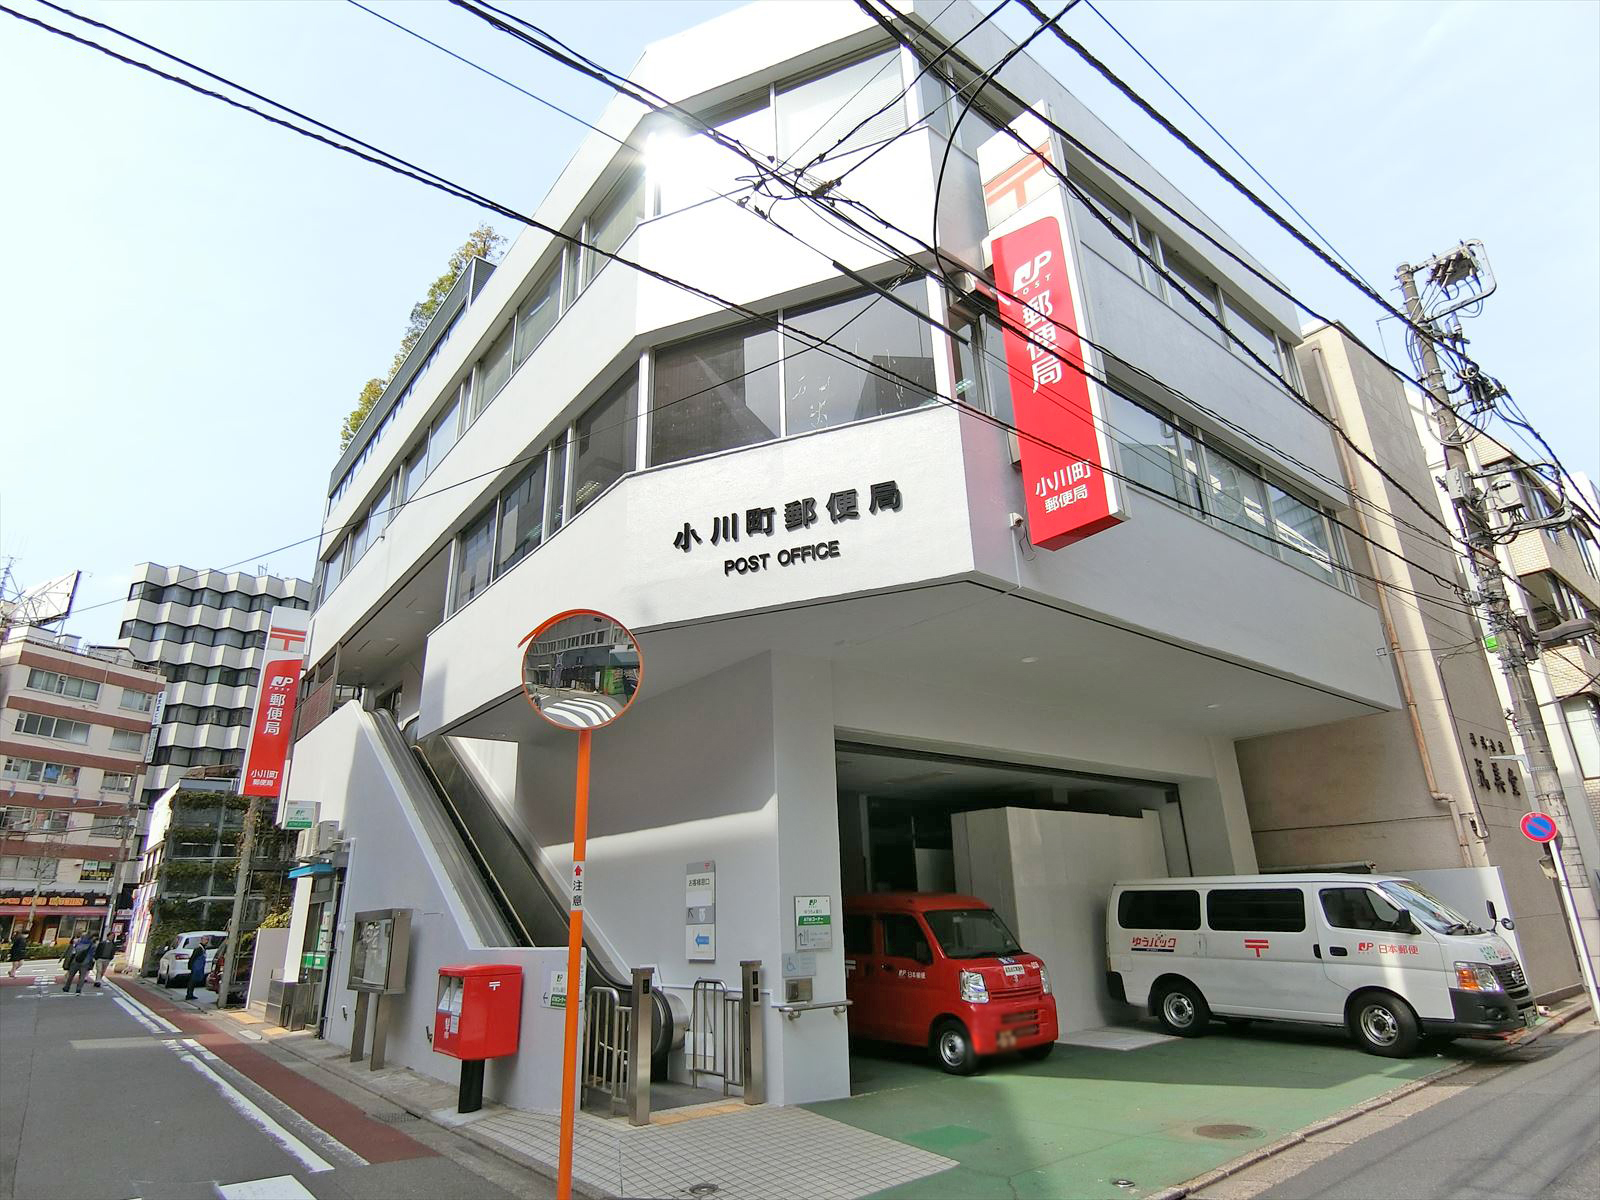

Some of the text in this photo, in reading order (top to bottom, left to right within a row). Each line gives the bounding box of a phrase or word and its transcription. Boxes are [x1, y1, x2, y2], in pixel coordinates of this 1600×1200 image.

[1022, 289, 1063, 394] 郵便局
[1035, 459, 1091, 497] 小川町
[673, 480, 903, 552] 小川町郵便局
[1045, 484, 1088, 513] 郵便局
[724, 540, 841, 577] POST OFFICE
[263, 693, 286, 735] 郵便局
[251, 769, 279, 779] 小川町
[572, 879, 583, 907] 注意
[1379, 944, 1419, 955] 日本郵便
